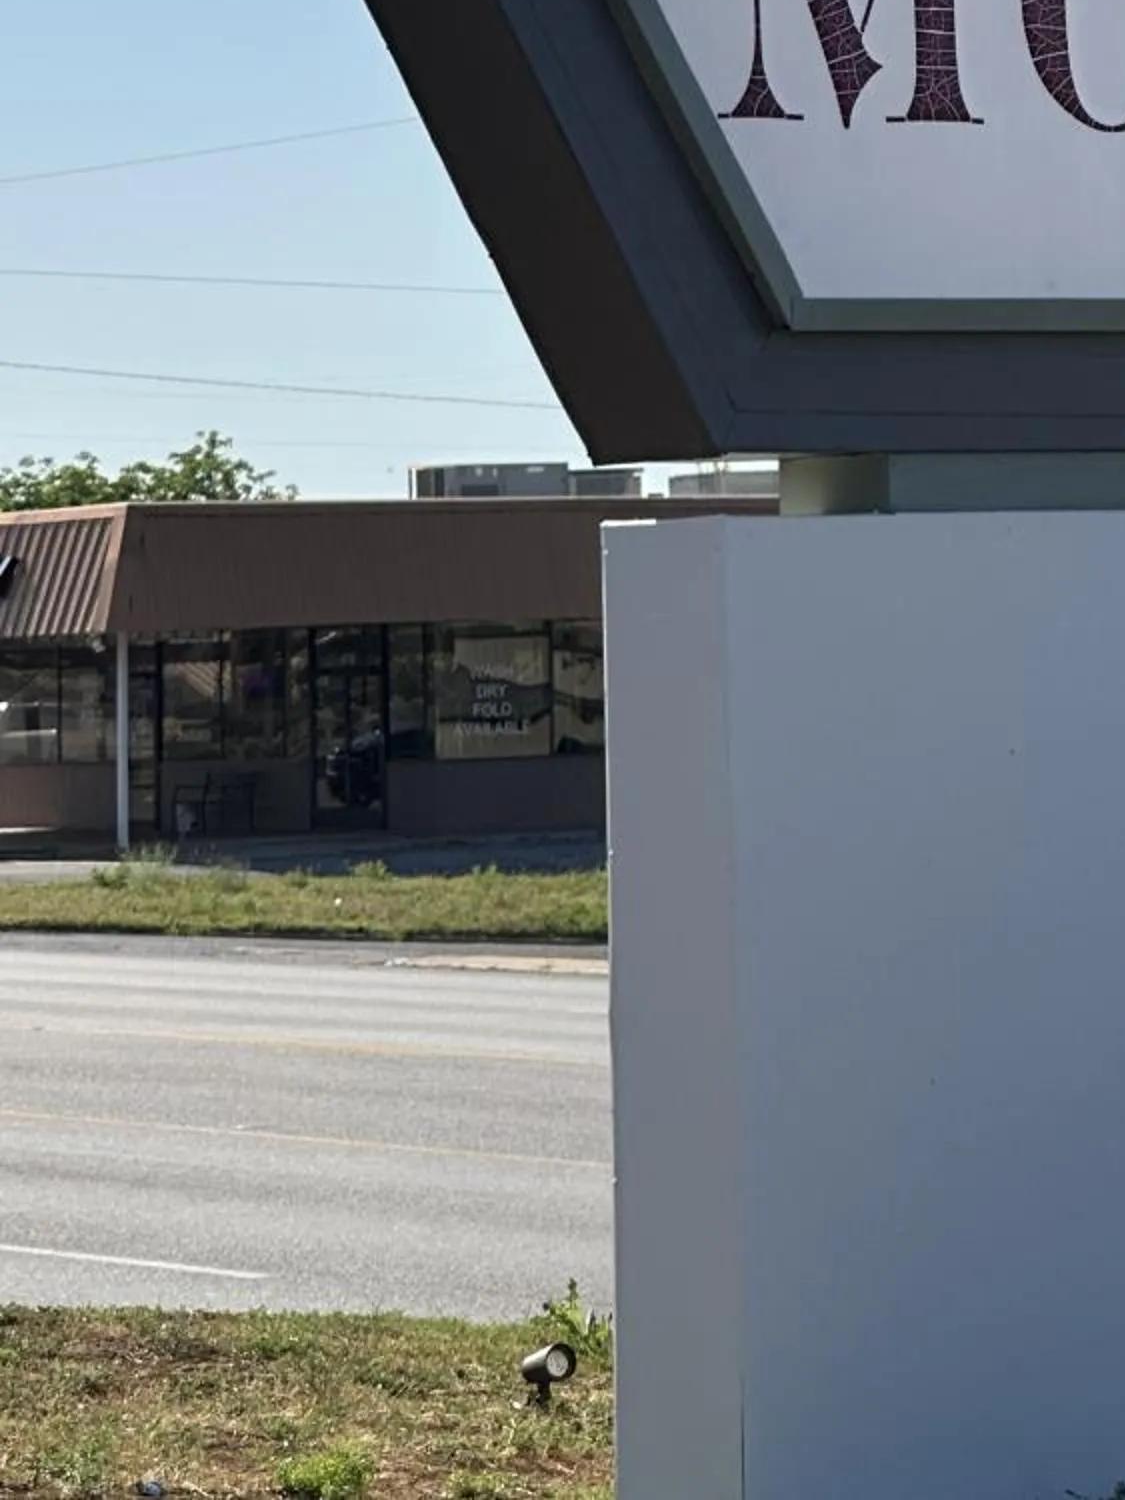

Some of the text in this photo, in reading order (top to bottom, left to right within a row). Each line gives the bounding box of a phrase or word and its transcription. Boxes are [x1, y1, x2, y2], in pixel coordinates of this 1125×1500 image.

[475, 683, 509, 699] DRY
[471, 702, 513, 717] FOLD
[453, 719, 530, 737] AVAILABLE
